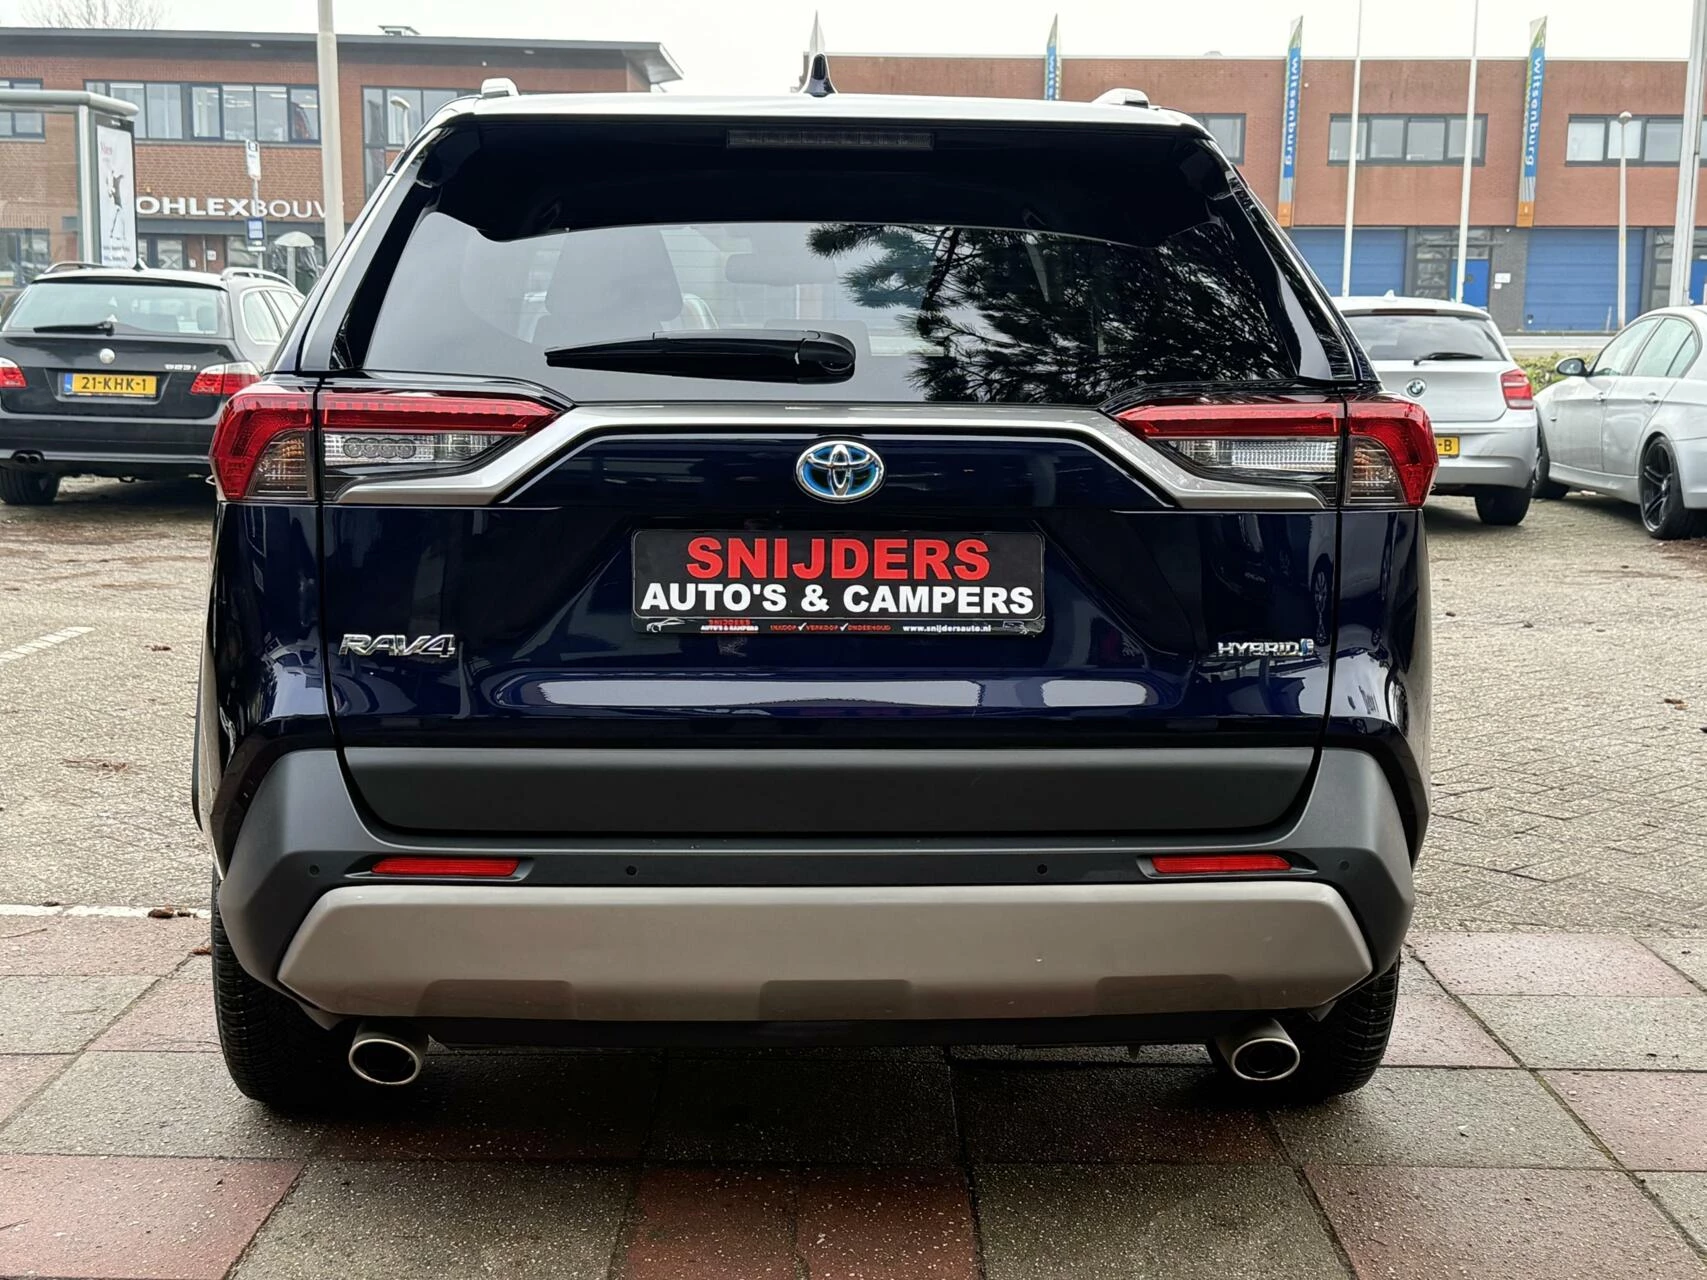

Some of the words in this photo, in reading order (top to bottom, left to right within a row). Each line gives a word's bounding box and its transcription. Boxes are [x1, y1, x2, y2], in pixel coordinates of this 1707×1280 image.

[81, 376, 147, 392] 21-KHK-1
[686, 537, 991, 581] SNIJDERS
[641, 582, 788, 613] AUTO'S
[800, 584, 830, 613] &
[843, 585, 1034, 614] CAMPERS
[902, 624, 992, 633] www.snijdersauto.nl
[338, 633, 456, 658] RAV4
[1217, 642, 1300, 657] HYBRID
